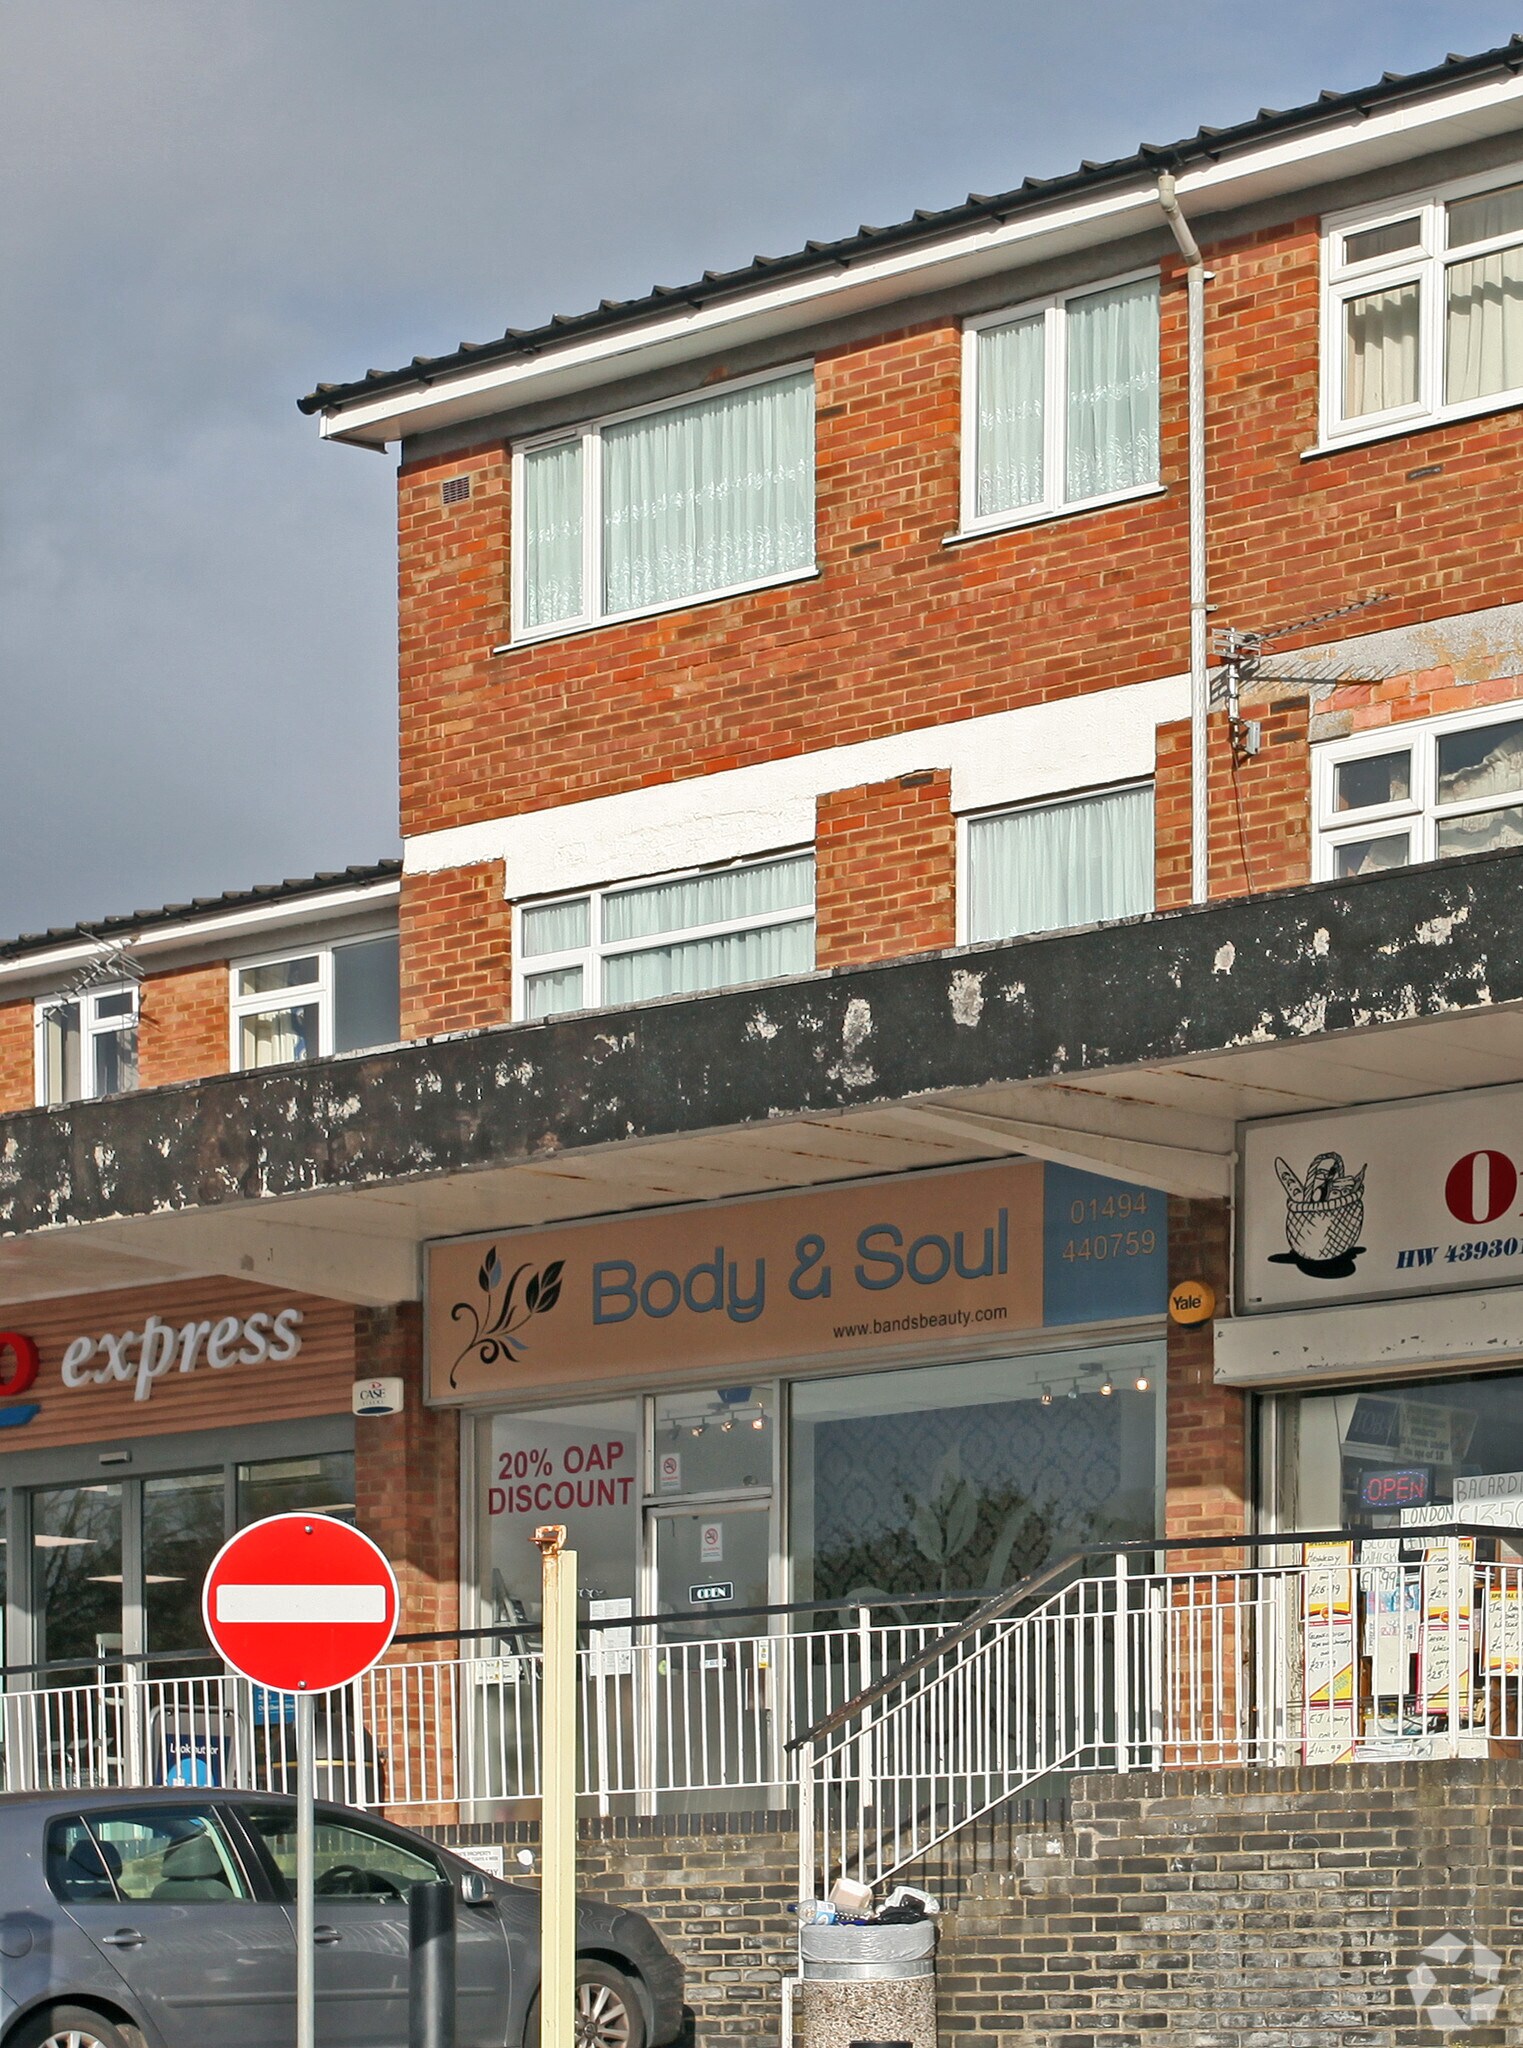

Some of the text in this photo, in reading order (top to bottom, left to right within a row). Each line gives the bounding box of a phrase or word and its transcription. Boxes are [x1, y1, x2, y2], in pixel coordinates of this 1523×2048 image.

[1070, 1191, 1148, 1226] 01494
[1061, 1229, 1157, 1264] 440759
[1396, 1246, 1440, 1270] HW
[592, 1207, 1009, 1324] Body & Soul
[1172, 1294, 1202, 1310] Yale
[833, 1304, 1008, 1340] www.bandsbeauty.com
[61, 1308, 303, 1401] express
[498, 1441, 625, 1480] 20% OAP
[488, 1476, 635, 1515] DISCOUNT
[1367, 1477, 1425, 1501] OPEN
[697, 1587, 726, 1599] OPEN
[170, 1743, 192, 1754] Lok
